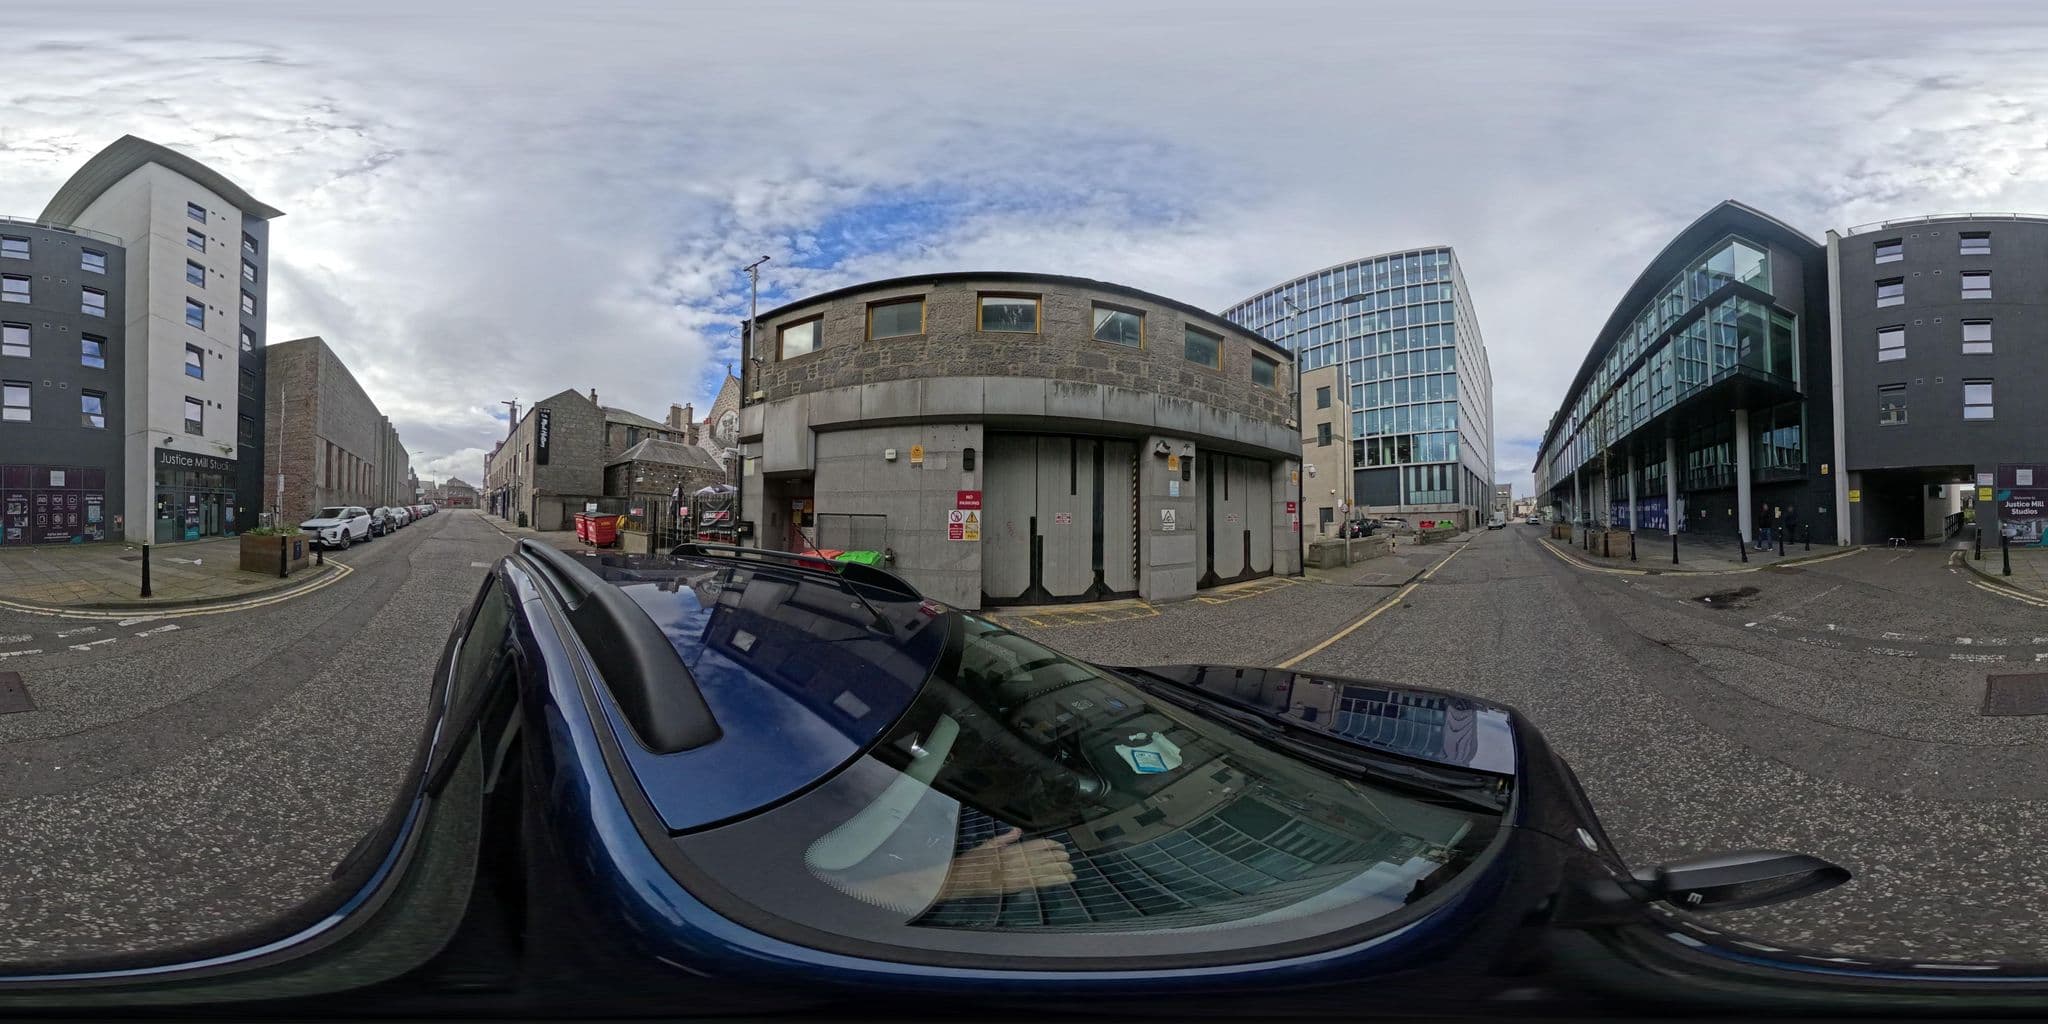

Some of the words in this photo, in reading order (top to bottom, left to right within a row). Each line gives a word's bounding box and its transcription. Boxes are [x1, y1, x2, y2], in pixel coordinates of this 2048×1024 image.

[160, 453, 193, 466] Justice
[194, 458, 208, 468] Mill
[209, 459, 235, 472] Studi
